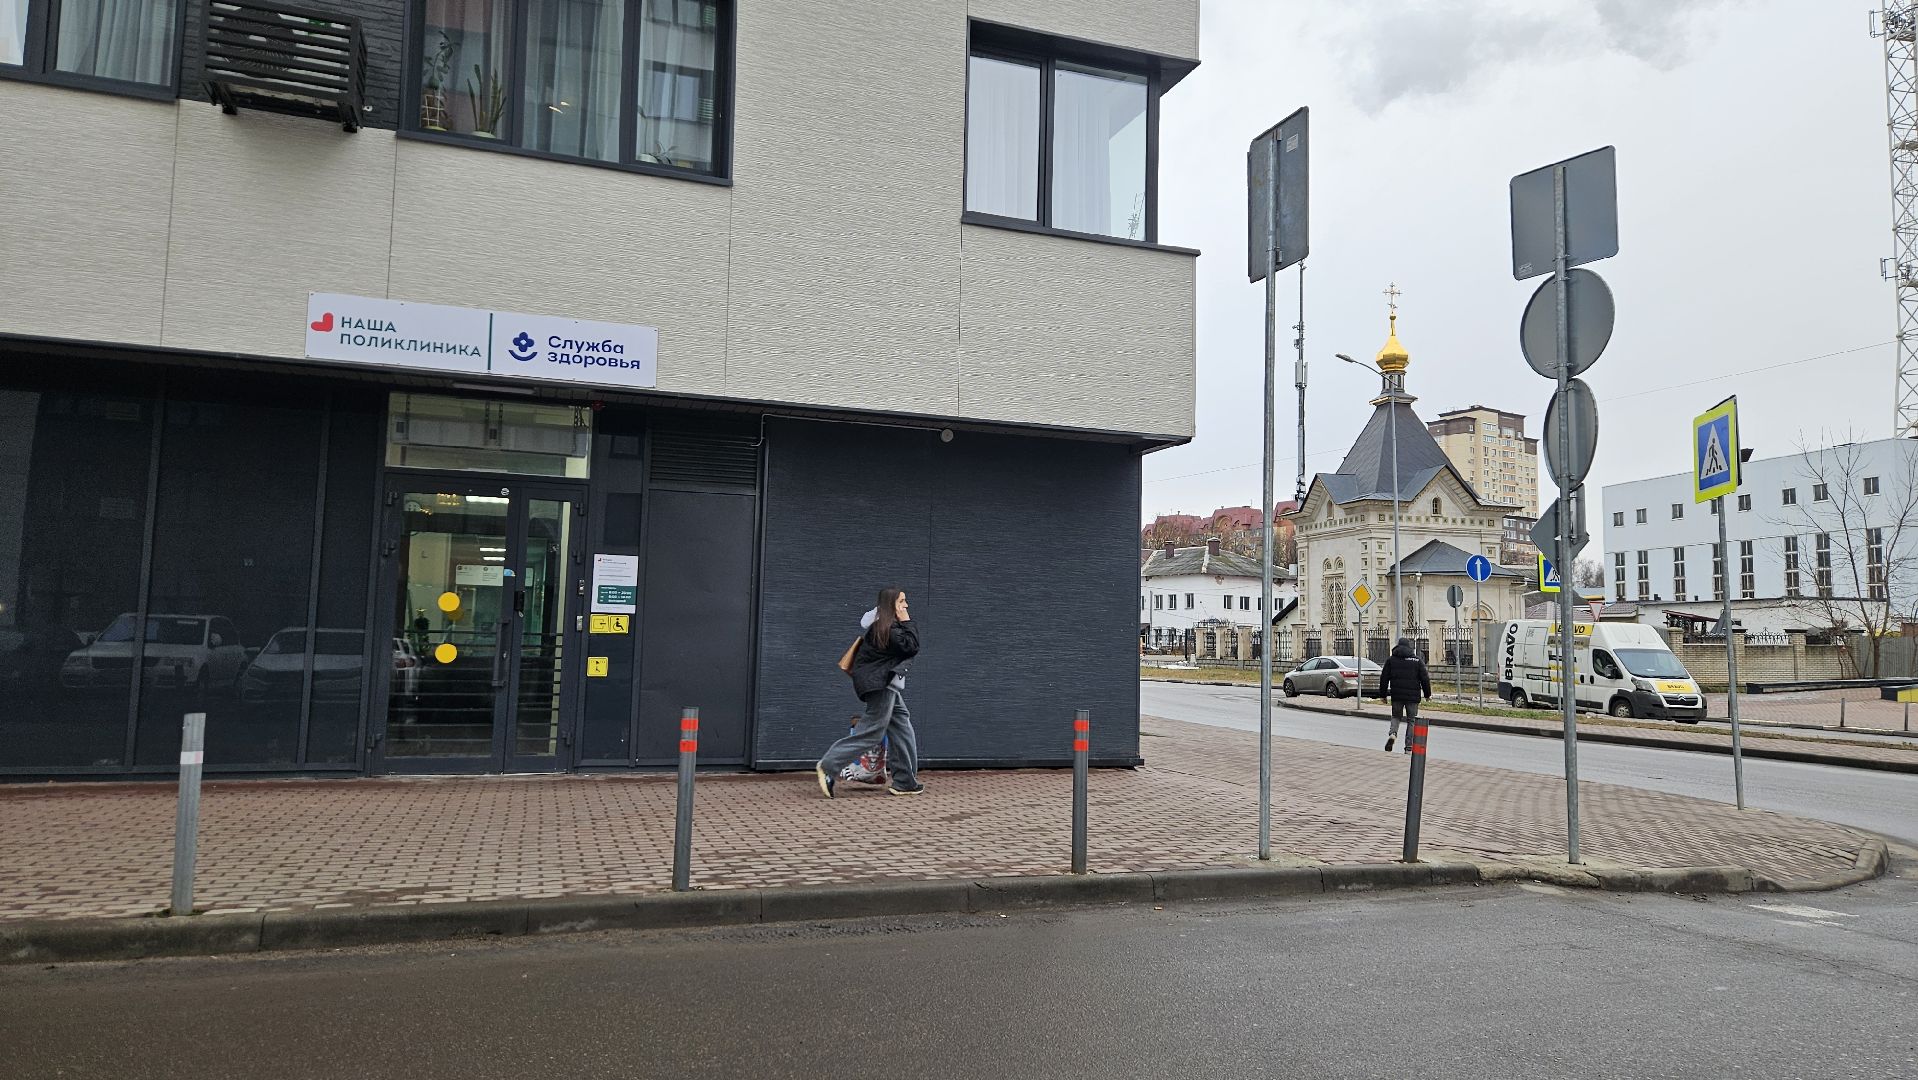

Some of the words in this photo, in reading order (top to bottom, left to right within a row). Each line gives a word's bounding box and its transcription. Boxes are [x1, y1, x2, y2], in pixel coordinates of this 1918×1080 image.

[341, 316, 397, 333] НАША
[340, 333, 482, 357] ПОЛИКЛИНИКА
[548, 335, 624, 355] Служба
[547, 351, 641, 370] здоровья
[1505, 623, 1518, 681] BRAVO
